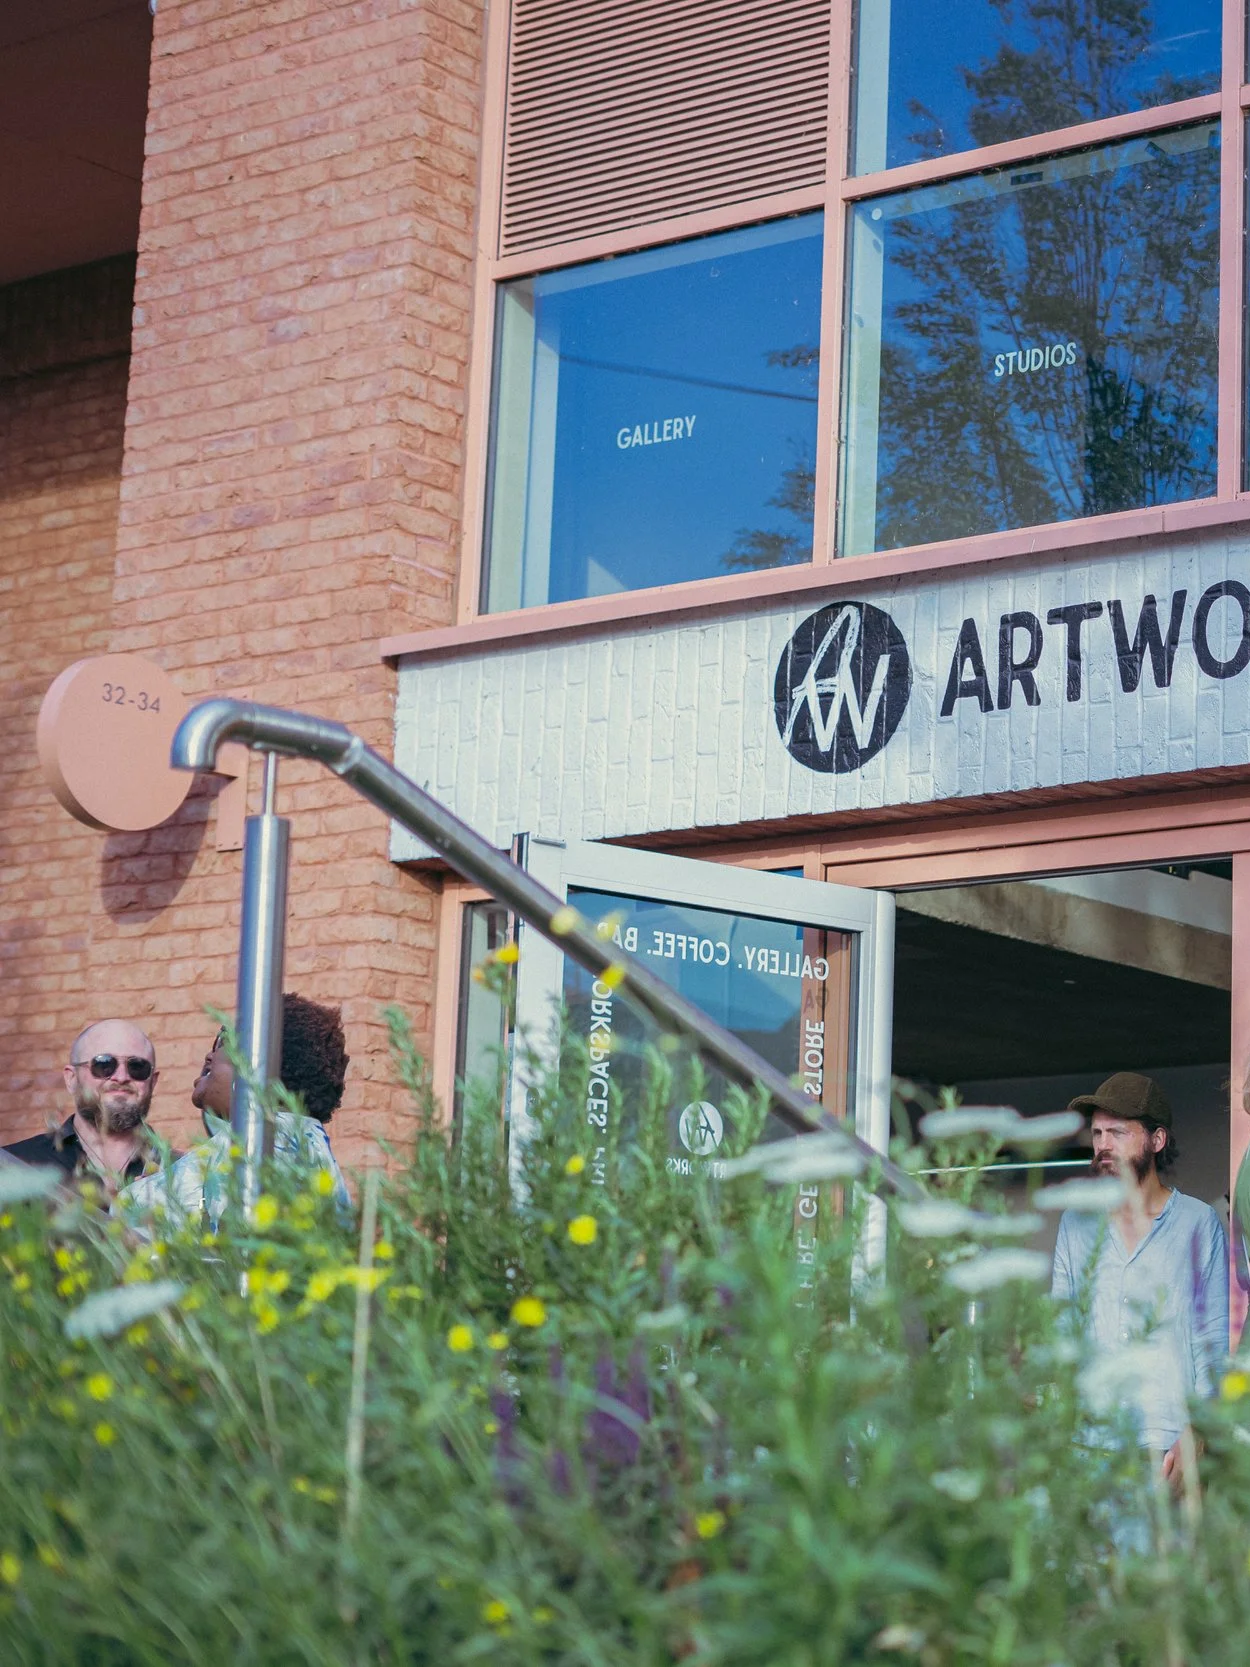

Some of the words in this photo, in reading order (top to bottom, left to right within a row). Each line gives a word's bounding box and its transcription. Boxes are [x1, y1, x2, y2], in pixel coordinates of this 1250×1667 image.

[994, 342, 1077, 377] STUDIOS
[617, 415, 697, 449] GALLERY
[102, 683, 161, 714] 32-34
